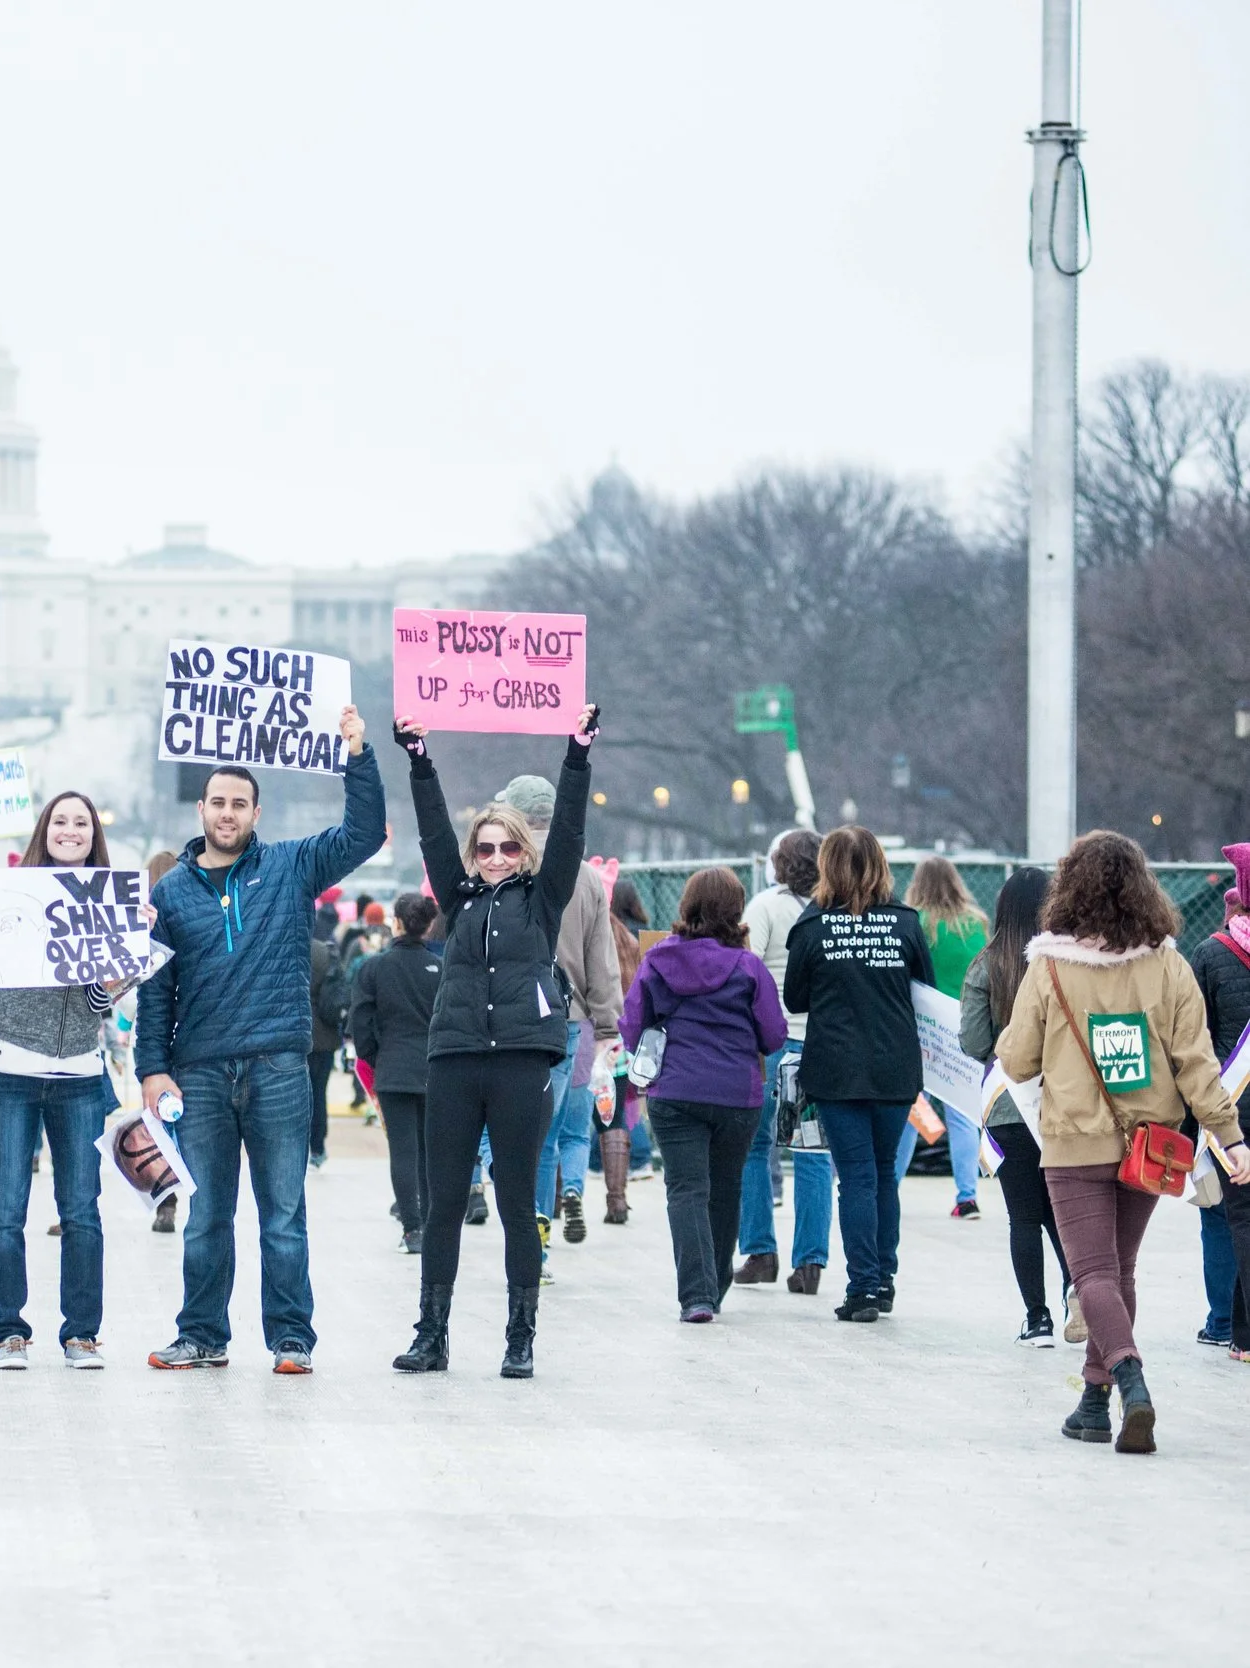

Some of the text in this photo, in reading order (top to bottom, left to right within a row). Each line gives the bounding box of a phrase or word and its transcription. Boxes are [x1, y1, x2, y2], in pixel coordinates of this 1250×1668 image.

[436, 621, 507, 657] PUSSY
[508, 635, 520, 650] is
[524, 628, 582, 657] NOT
[170, 646, 314, 692] NO SUCH
[166, 681, 312, 729] THING AS
[417, 675, 561, 710] UP for GRABS
[52, 870, 141, 905] WE
[45, 899, 149, 938] SHALL
[821, 912, 898, 925] People have
[831, 923, 893, 935] the Power
[46, 933, 132, 964] OVER
[822, 936, 902, 949] to redeem the
[825, 948, 900, 961] work of fools
[887, 959, 905, 968] Smith
[1094, 1028, 1138, 1038] VERMONT
